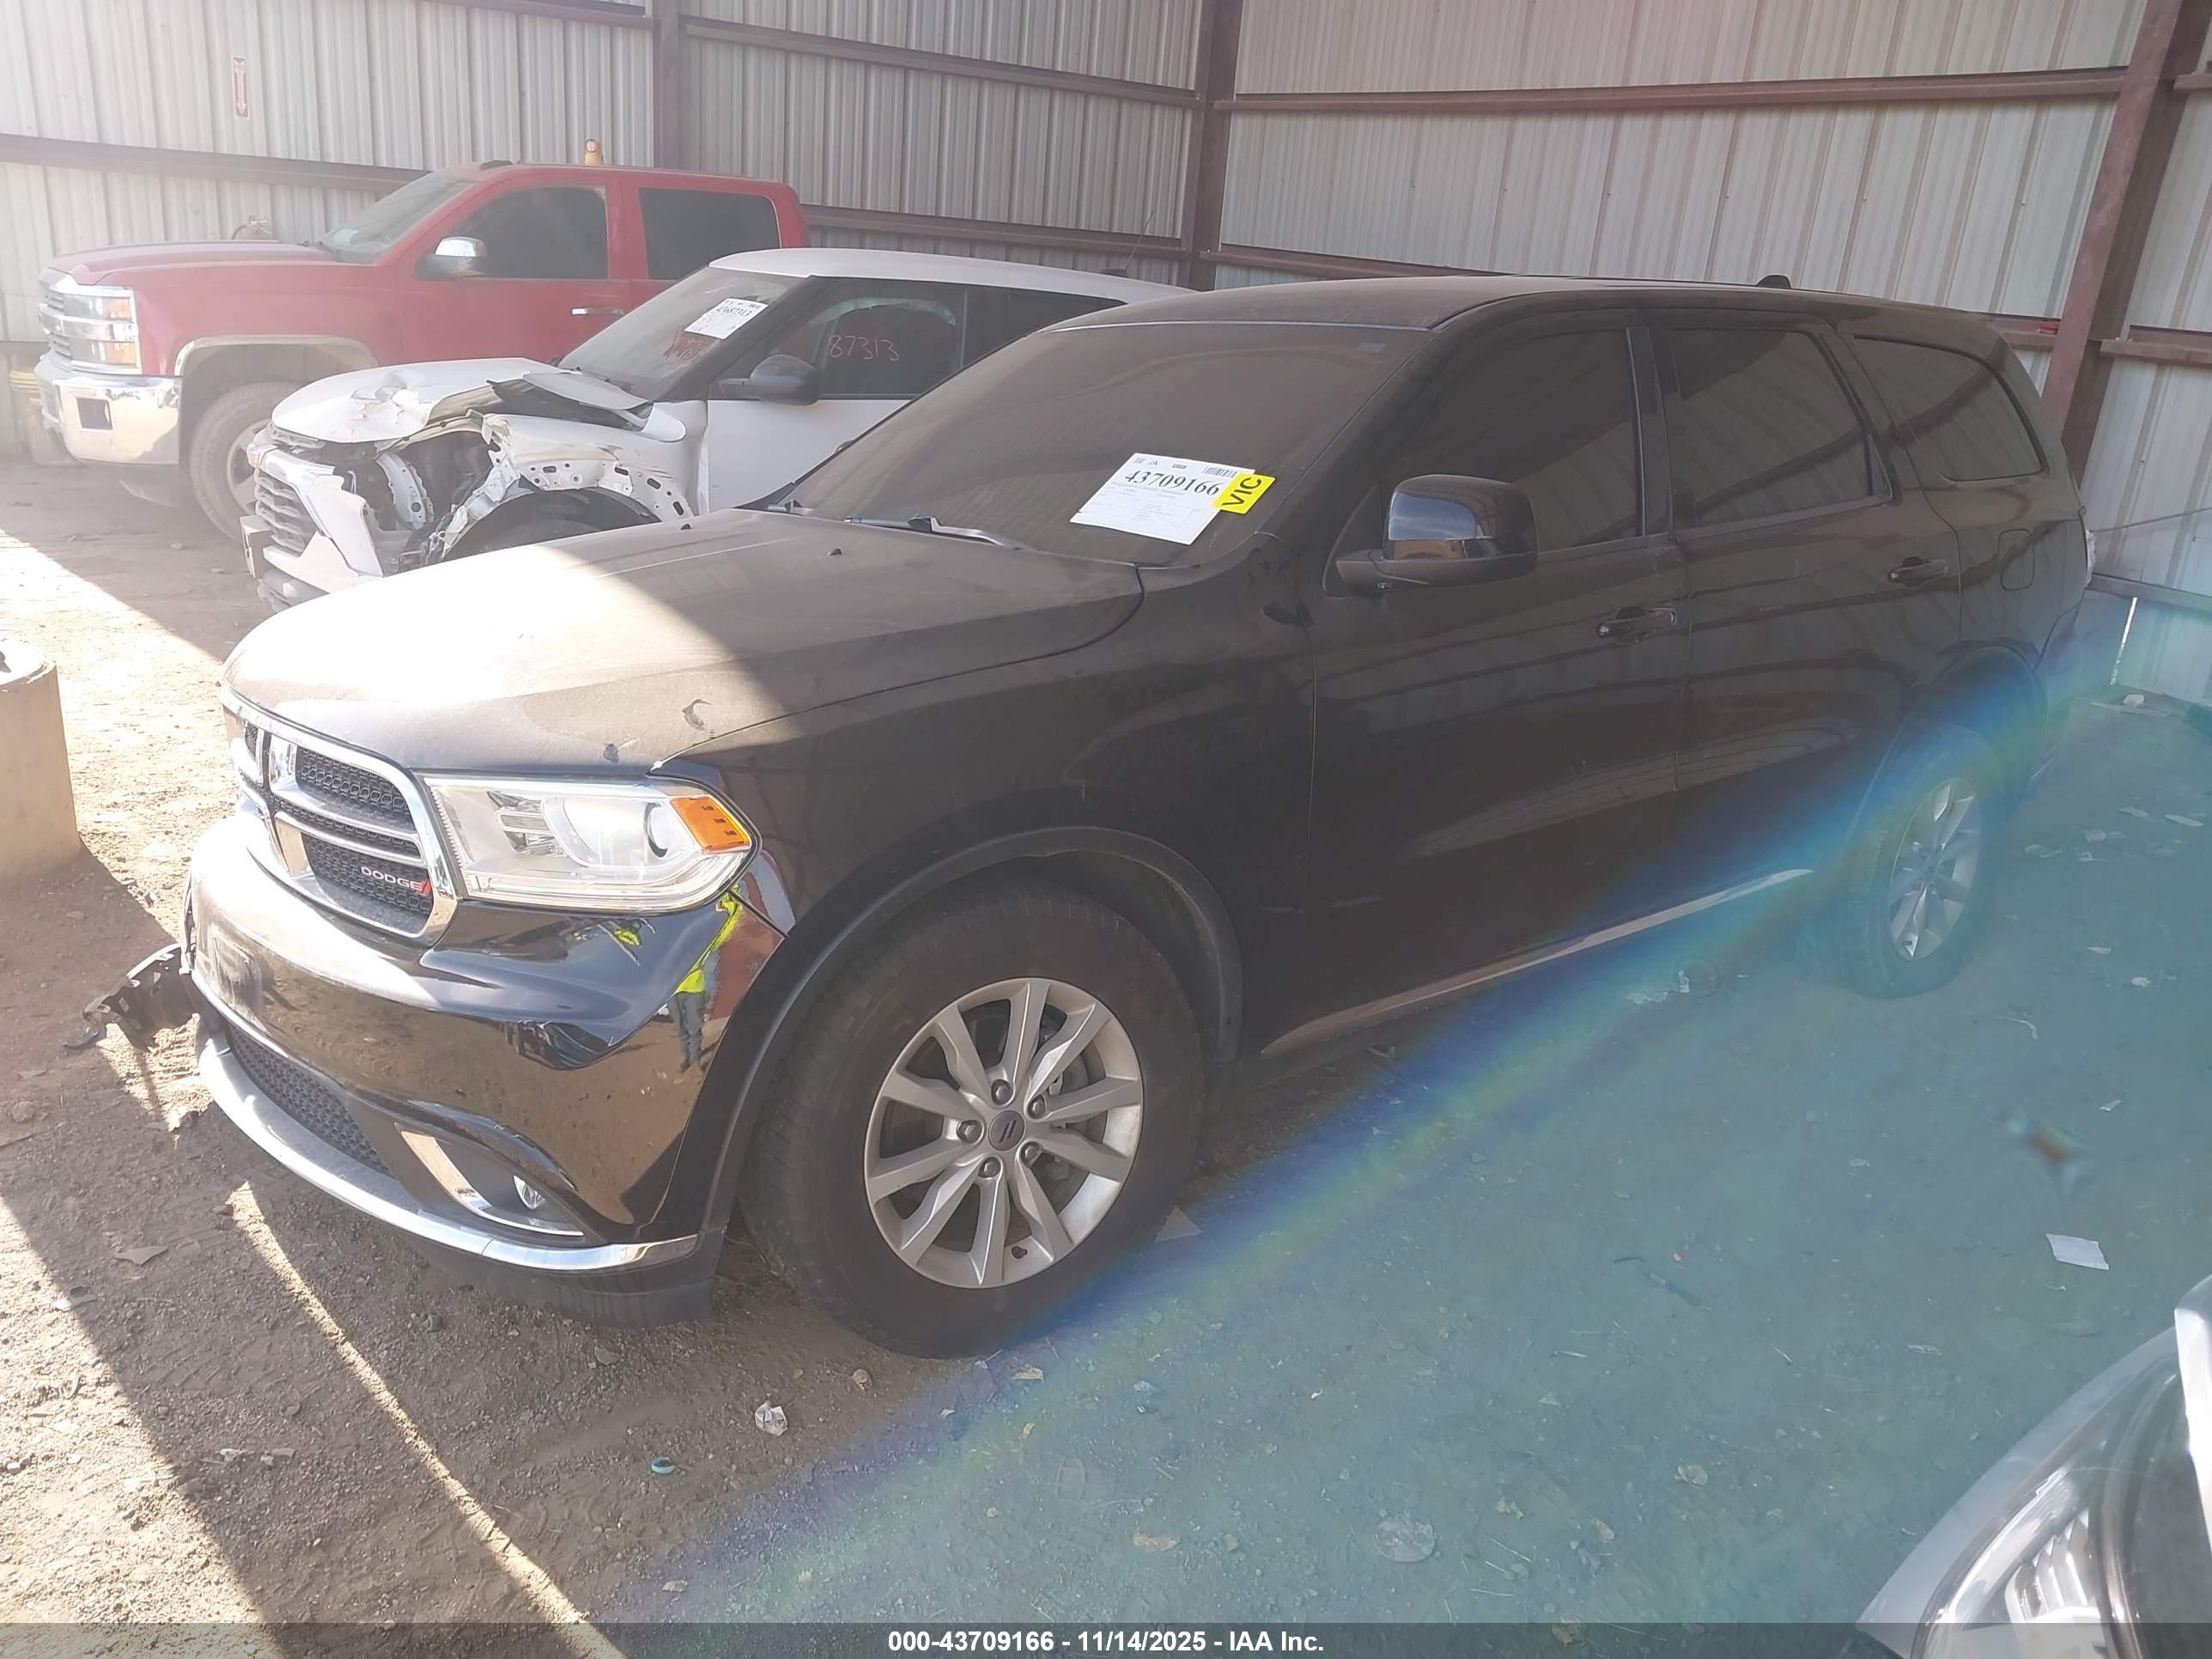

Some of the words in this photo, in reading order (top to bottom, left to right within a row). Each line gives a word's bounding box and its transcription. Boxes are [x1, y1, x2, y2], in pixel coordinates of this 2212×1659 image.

[828, 335, 900, 362] 87313
[1125, 470, 1224, 497] 43709166
[1221, 476, 1263, 509] VIC
[360, 866, 423, 891] DODGE
